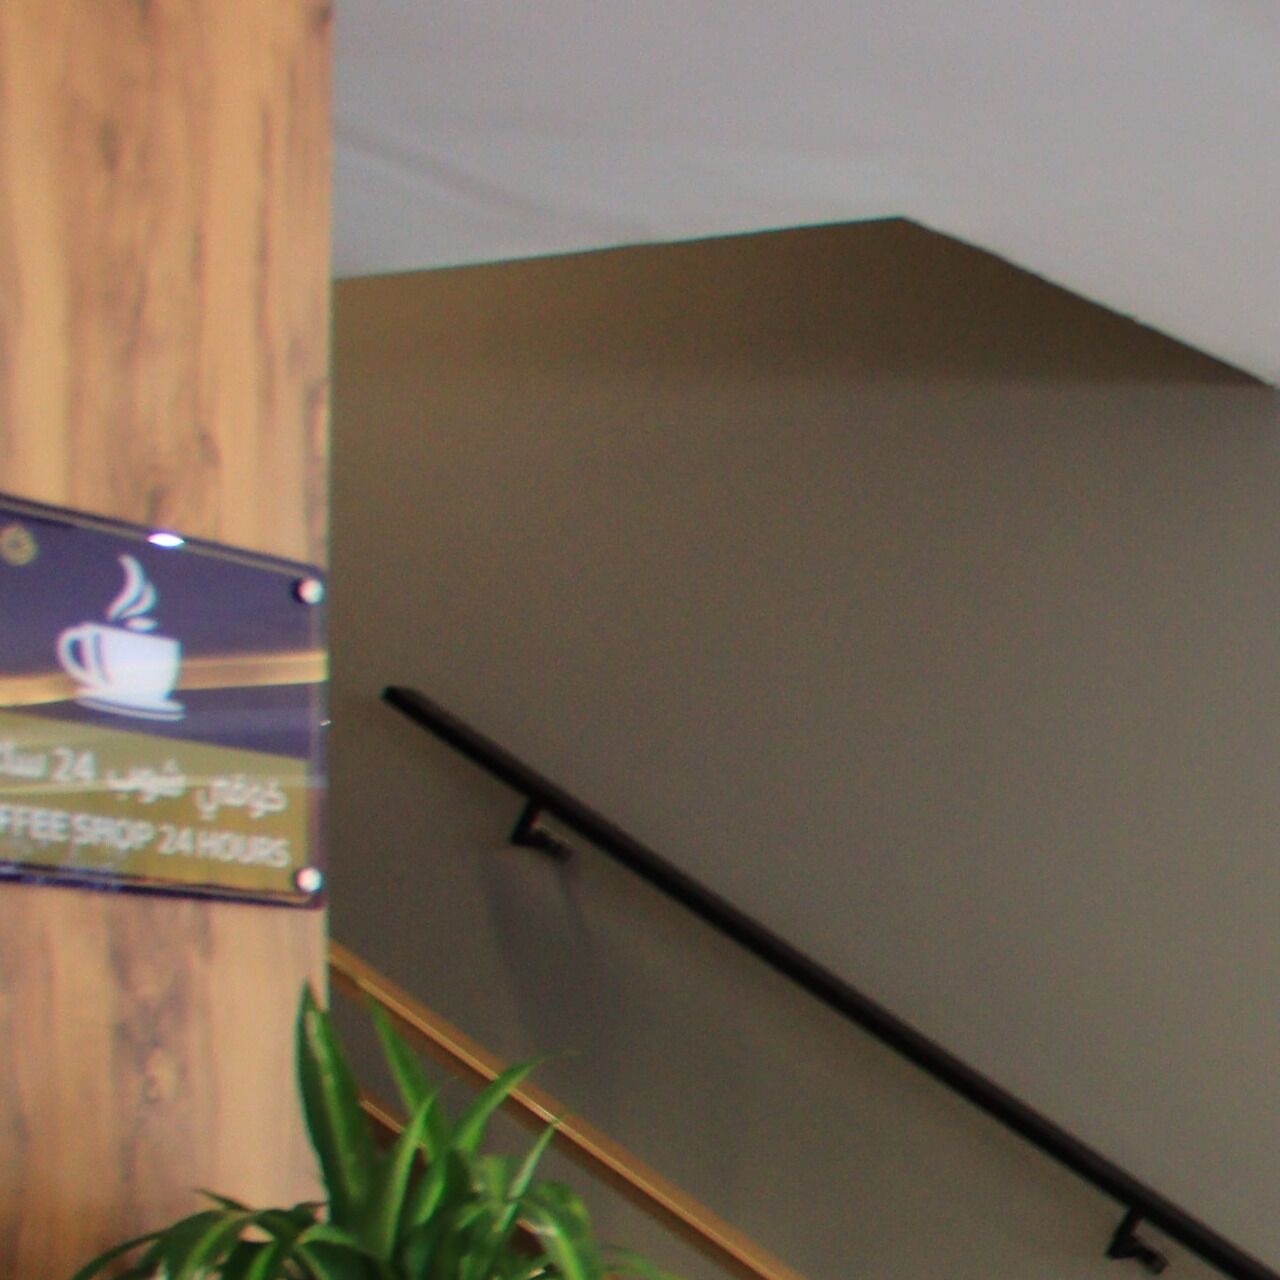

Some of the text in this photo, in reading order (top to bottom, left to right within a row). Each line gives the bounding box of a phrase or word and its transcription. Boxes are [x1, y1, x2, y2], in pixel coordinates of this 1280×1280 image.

[52, 747, 97, 783] 24
[157, 822, 195, 856] 24
[195, 829, 292, 870] HOURS
